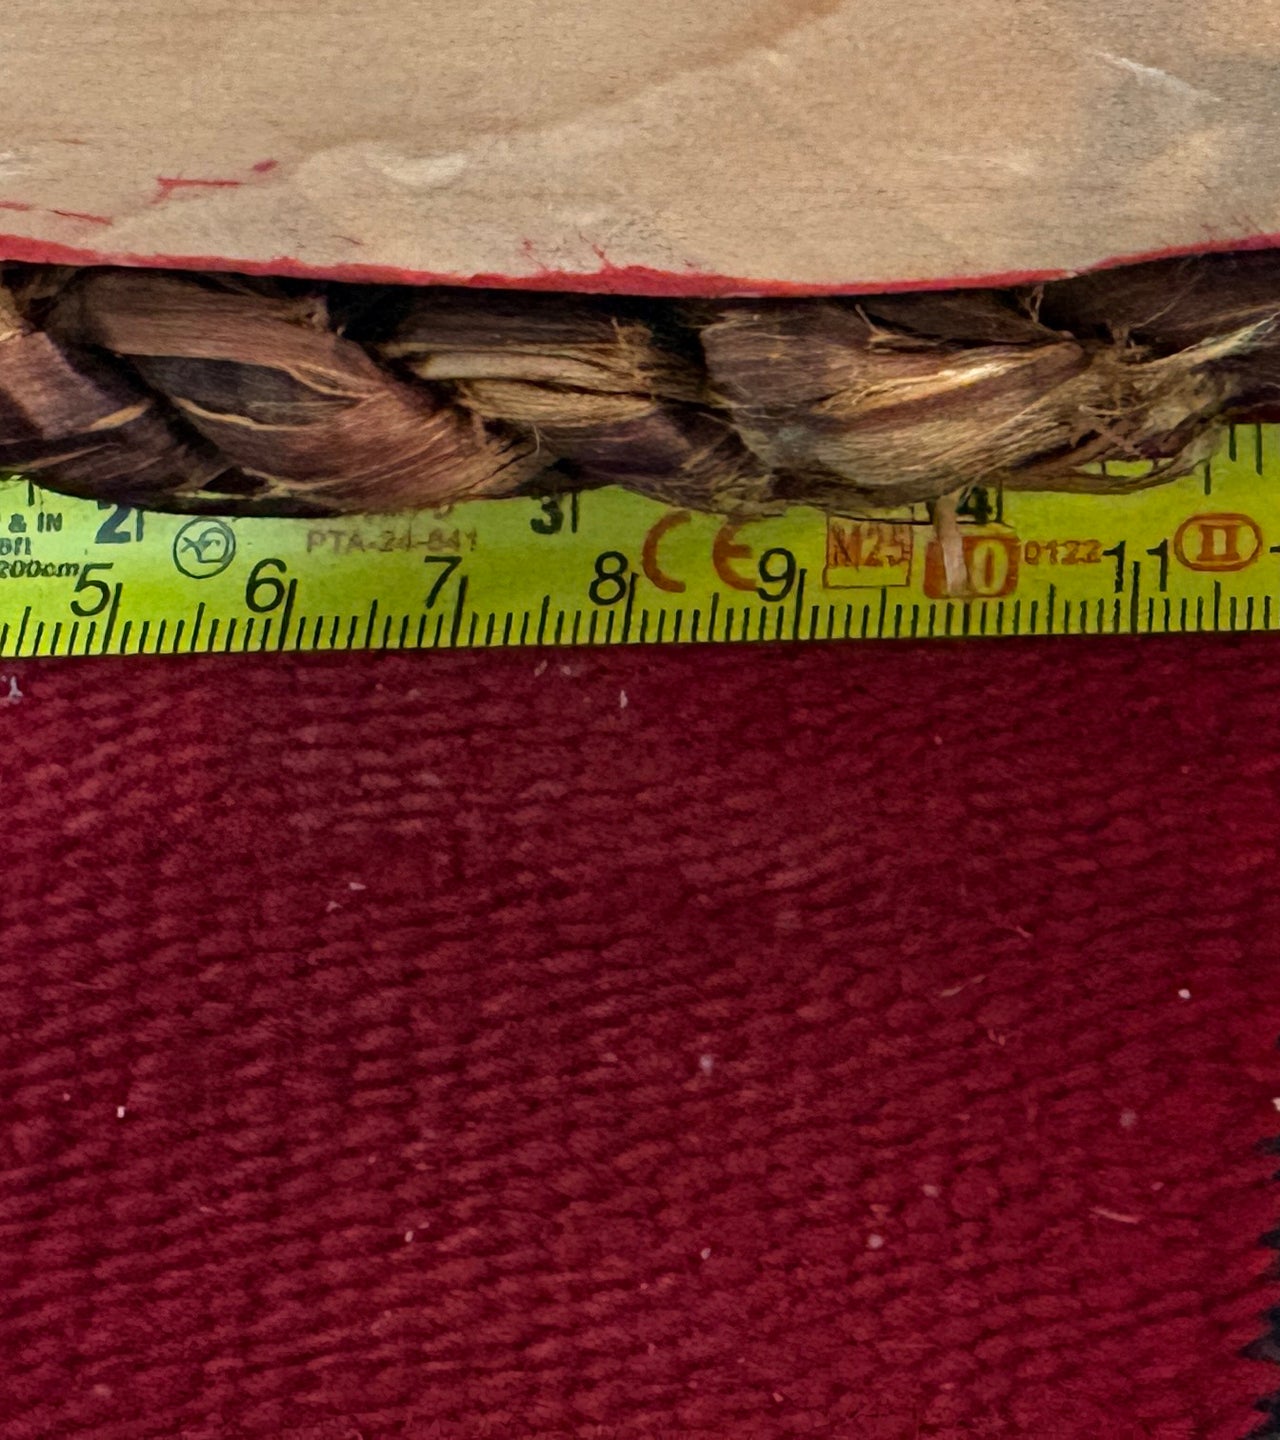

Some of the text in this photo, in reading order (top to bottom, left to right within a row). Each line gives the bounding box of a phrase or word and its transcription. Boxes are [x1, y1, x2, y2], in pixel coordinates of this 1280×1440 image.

[37, 512, 63, 533] IN
[95, 498, 131, 544] 2
[530, 490, 563, 534] 3
[956, 485, 993, 524] 4
[70, 563, 113, 617] 5
[246, 559, 288, 611] 6
[424, 555, 464, 608] 7
[589, 550, 628, 605] 8
[757, 548, 796, 602] 9
[1102, 539, 1168, 593] 11
[640, 511, 758, 592] CE
